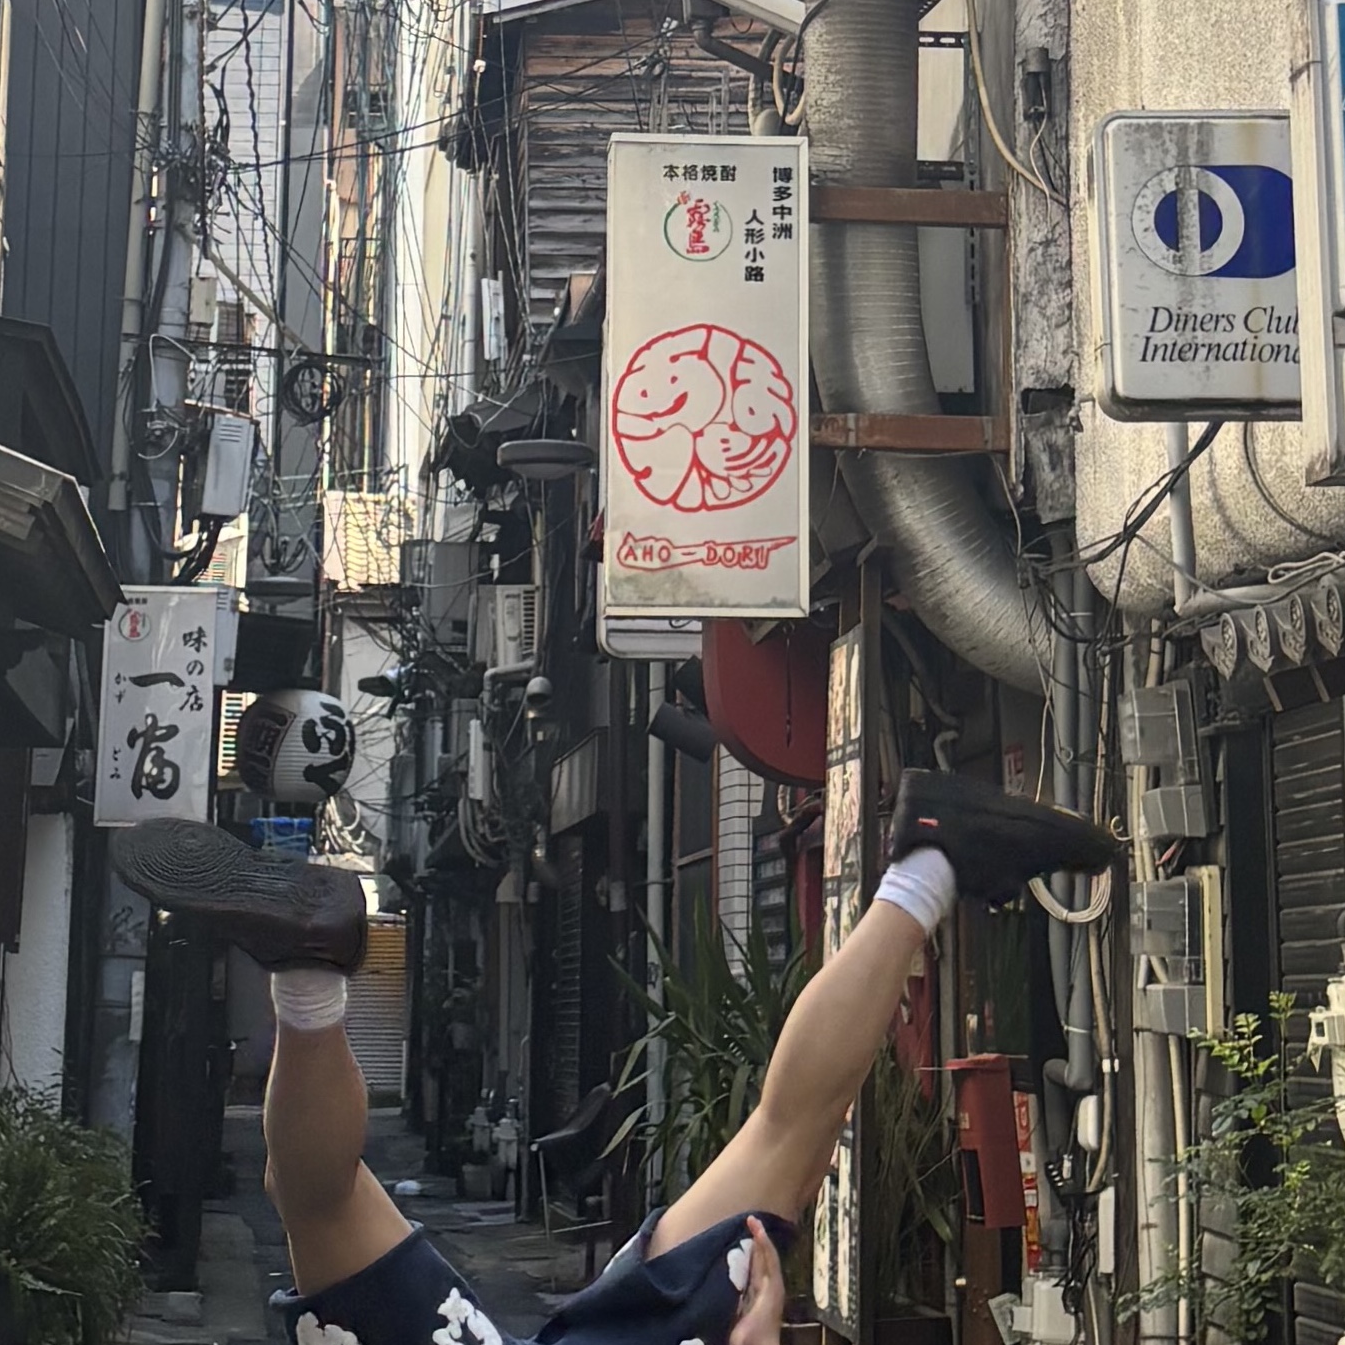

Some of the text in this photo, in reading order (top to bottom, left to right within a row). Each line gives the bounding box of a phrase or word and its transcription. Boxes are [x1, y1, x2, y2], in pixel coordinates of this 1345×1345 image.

[663, 164, 737, 182] 本格焼酎
[772, 166, 793, 240] 博多中洲
[744, 208, 765, 282] 人形小路
[1148, 306, 1236, 333] Diners
[1139, 335, 1301, 365] Internation
[179, 626, 207, 711] 味の店
